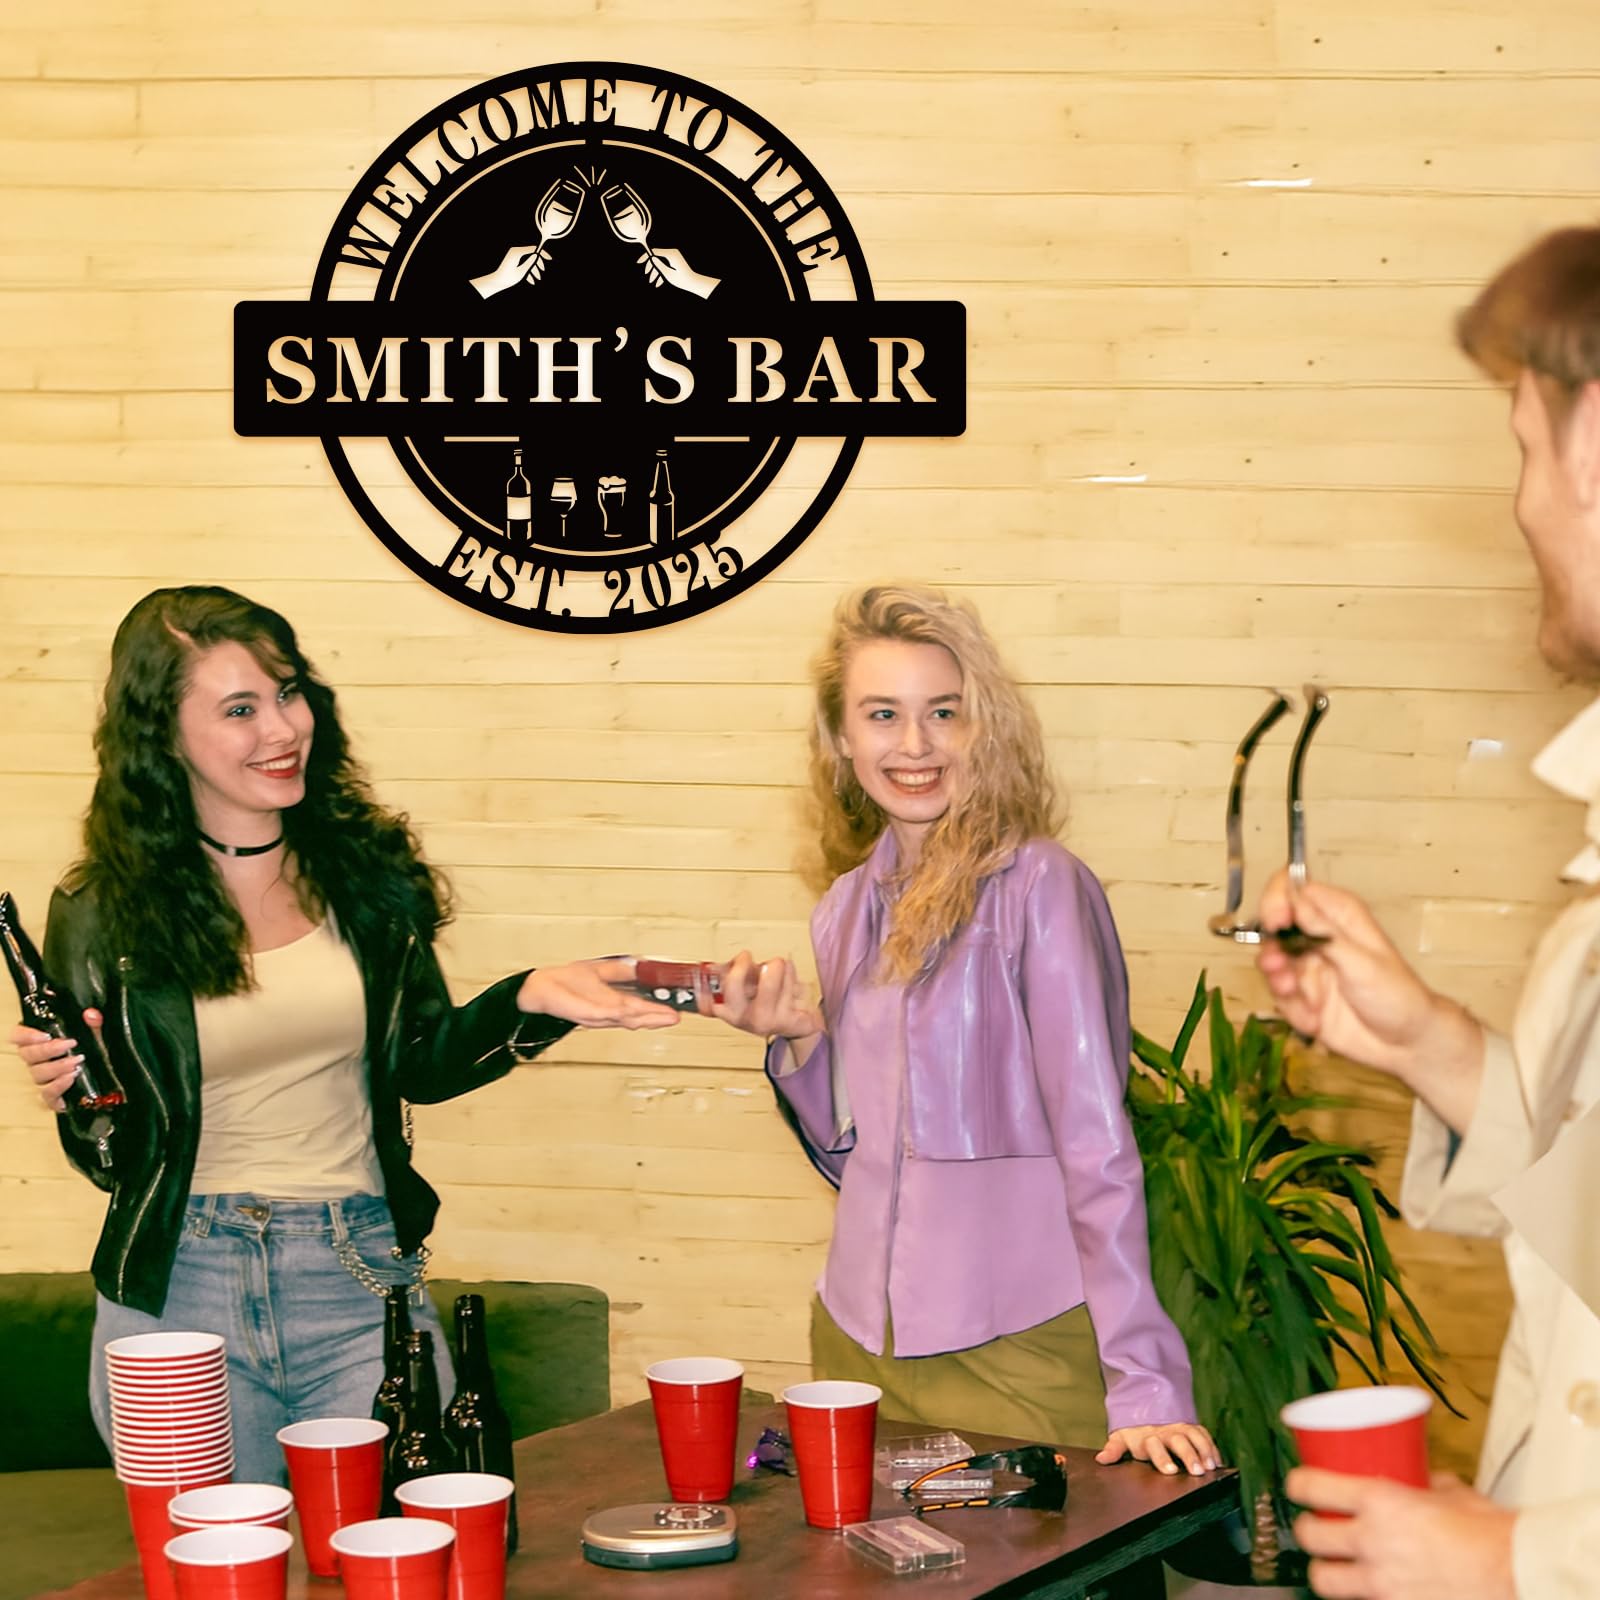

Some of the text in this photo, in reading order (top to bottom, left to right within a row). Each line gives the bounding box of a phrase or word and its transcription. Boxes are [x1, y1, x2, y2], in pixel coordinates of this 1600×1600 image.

[340, 78, 847, 272] WELCOME TO THE
[265, 326, 937, 405] SMITH'S BAR
[437, 529, 745, 618] EST. 2025
